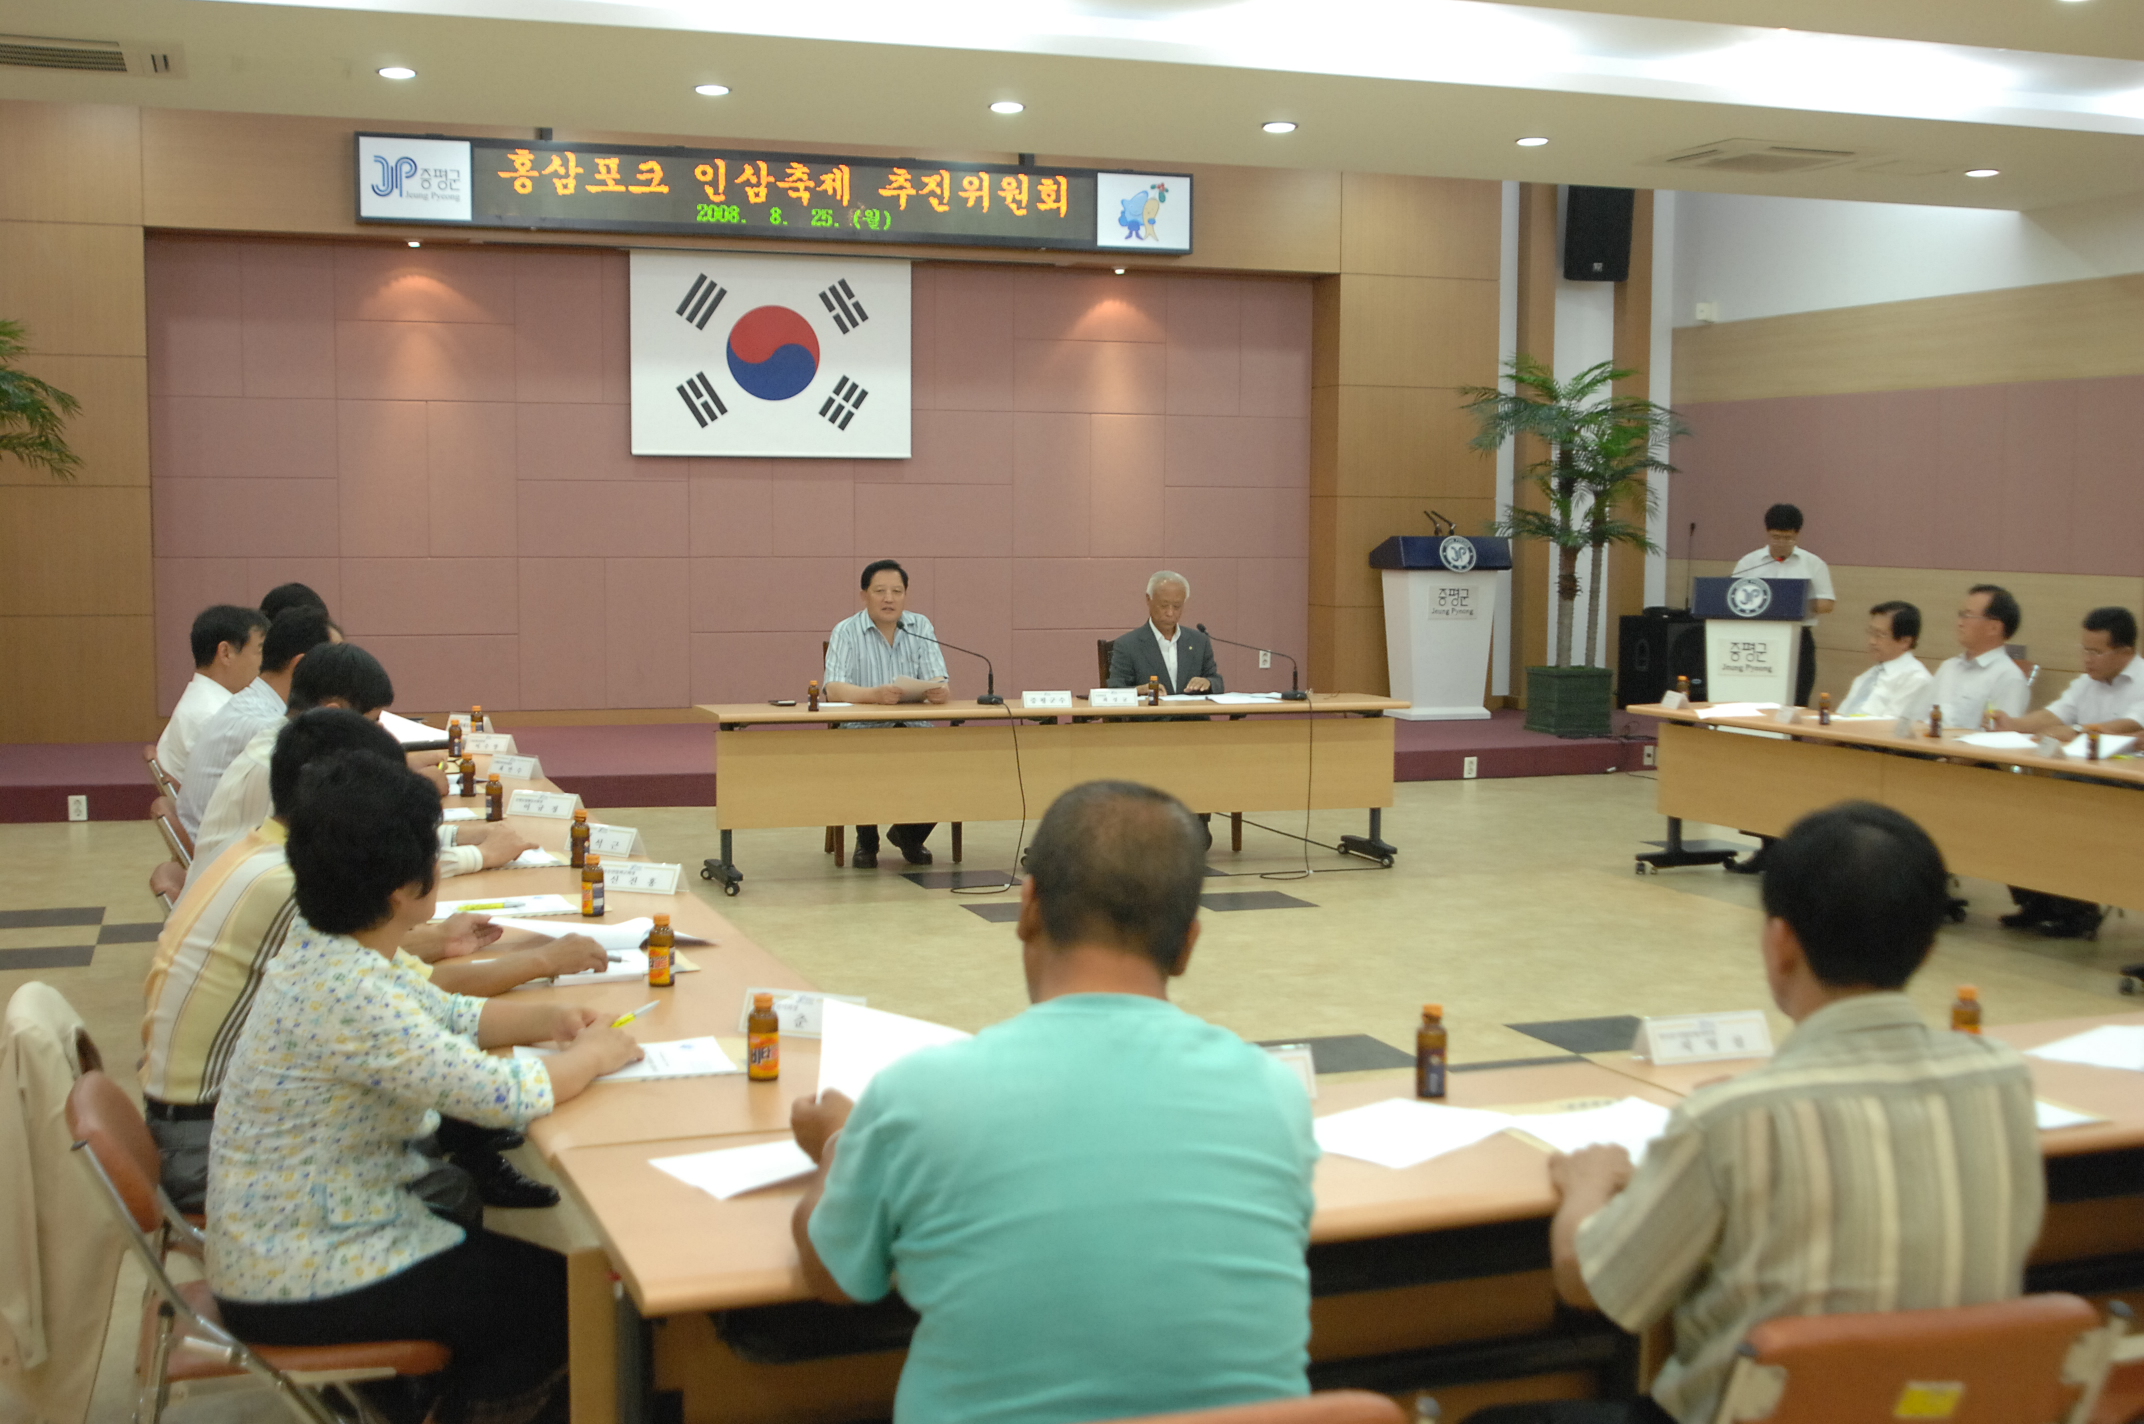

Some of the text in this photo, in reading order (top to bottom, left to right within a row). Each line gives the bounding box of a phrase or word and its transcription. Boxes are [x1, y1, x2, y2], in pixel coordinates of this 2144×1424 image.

[419, 167, 461, 192] 증평군
[497, 148, 1068, 218] 홍삼포크 인삼축제 추진위원회
[852, 208, 892, 231] (월)
[1438, 588, 1470, 607] 증평군
[1730, 641, 1768, 663] 증평군
